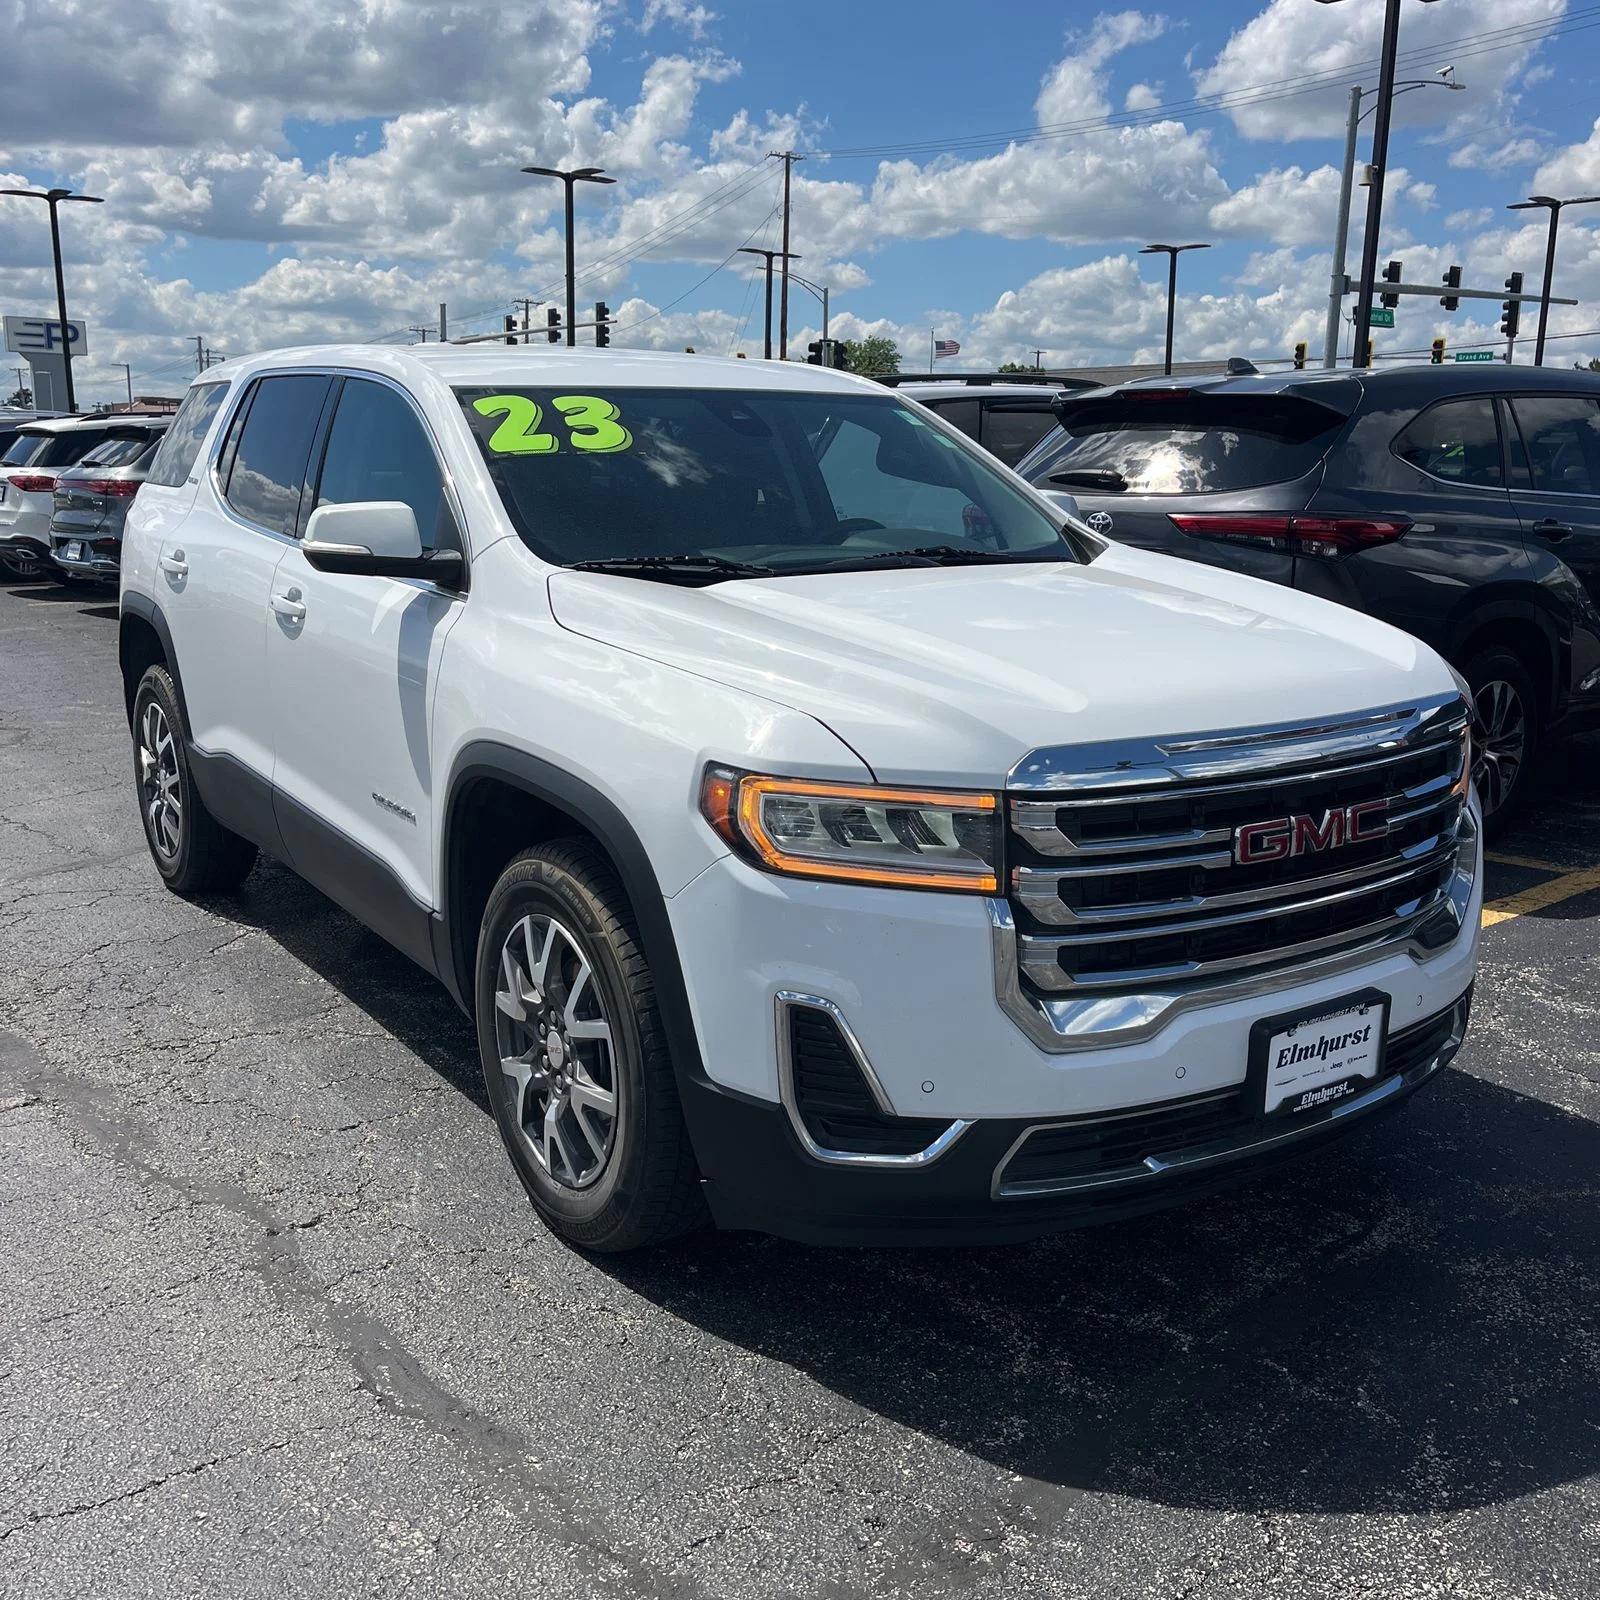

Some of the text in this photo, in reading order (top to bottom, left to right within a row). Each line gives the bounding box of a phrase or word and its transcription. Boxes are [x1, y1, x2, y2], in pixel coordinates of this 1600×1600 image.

[472, 395, 633, 455] 23
[1235, 798, 1390, 865] GMC
[1276, 1024, 1372, 1069] Elmhurst
[1301, 1081, 1348, 1105] Elmhurst
